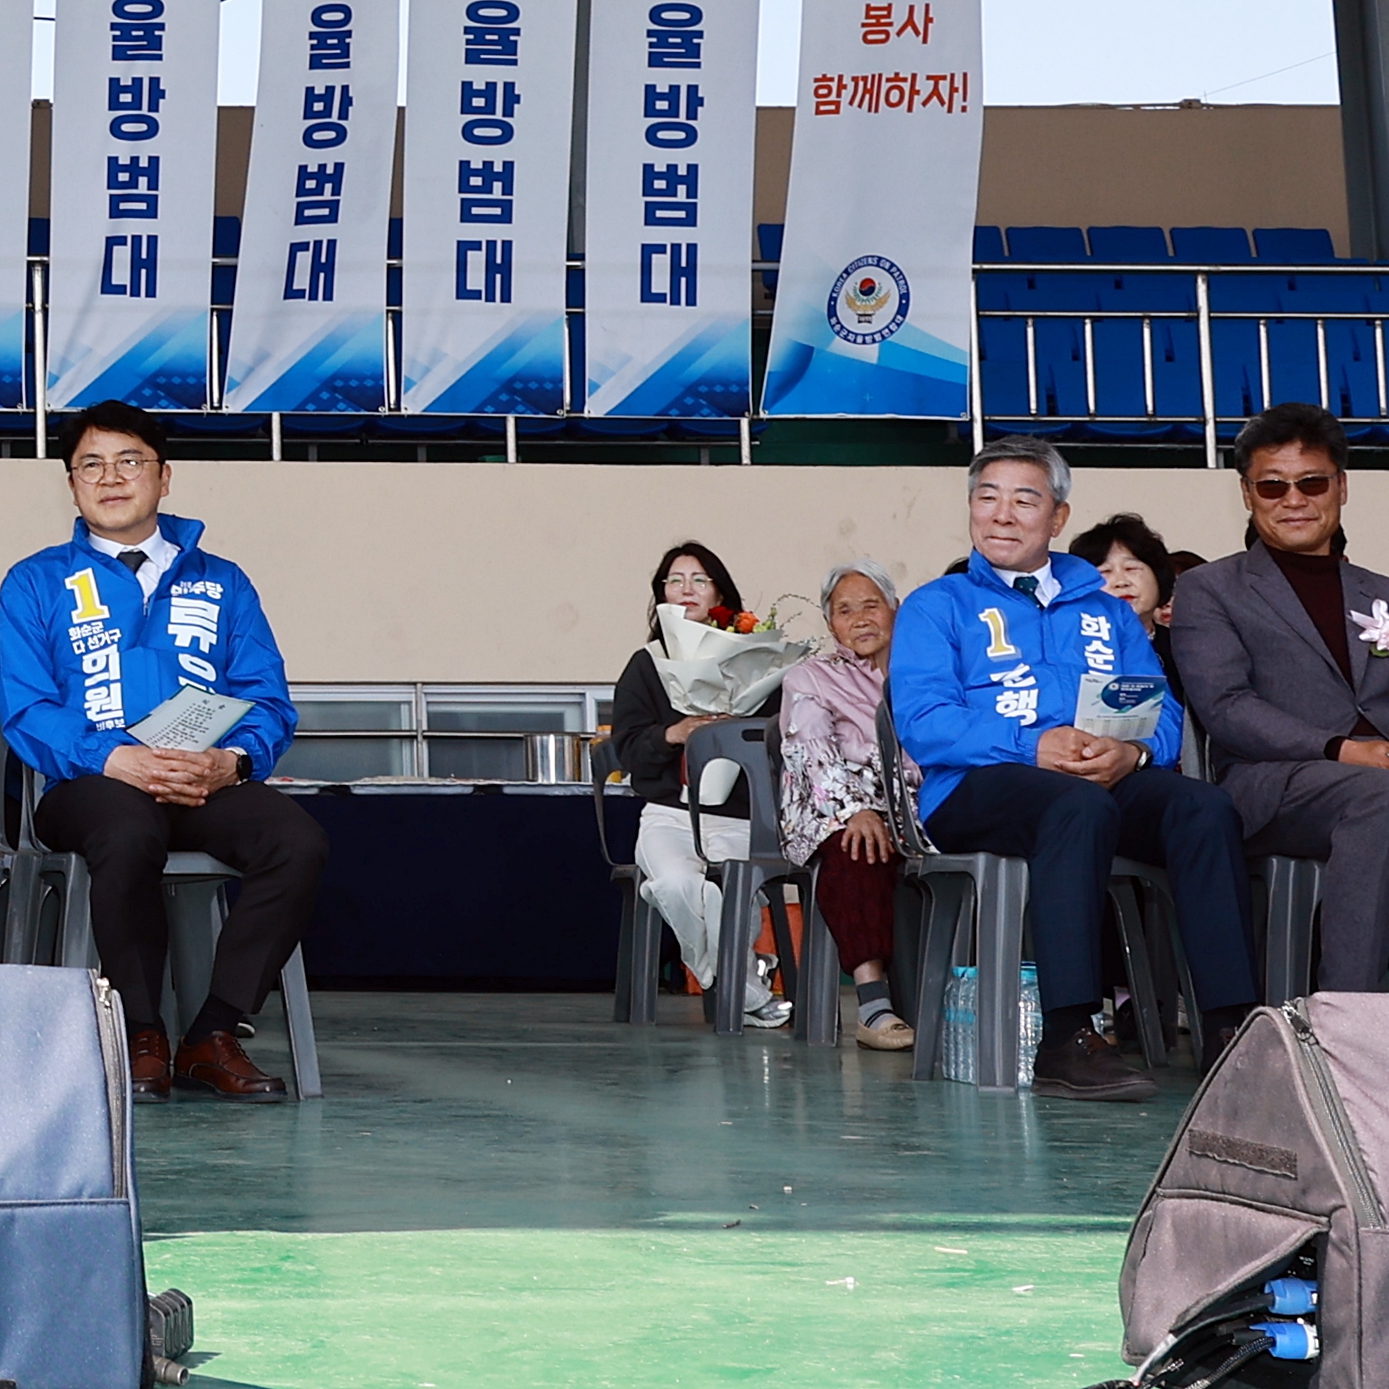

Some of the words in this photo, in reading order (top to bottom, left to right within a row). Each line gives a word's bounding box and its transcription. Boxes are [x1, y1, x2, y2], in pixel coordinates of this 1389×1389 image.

[862, 5, 933, 44] 봉사
[814, 73, 967, 115] 함께하자!
[64, 567, 111, 624] 1
[68, 621, 105, 642] 화순군
[87, 628, 122, 650] 선거구
[978, 607, 1018, 659] 1
[82, 644, 124, 722] 의원
